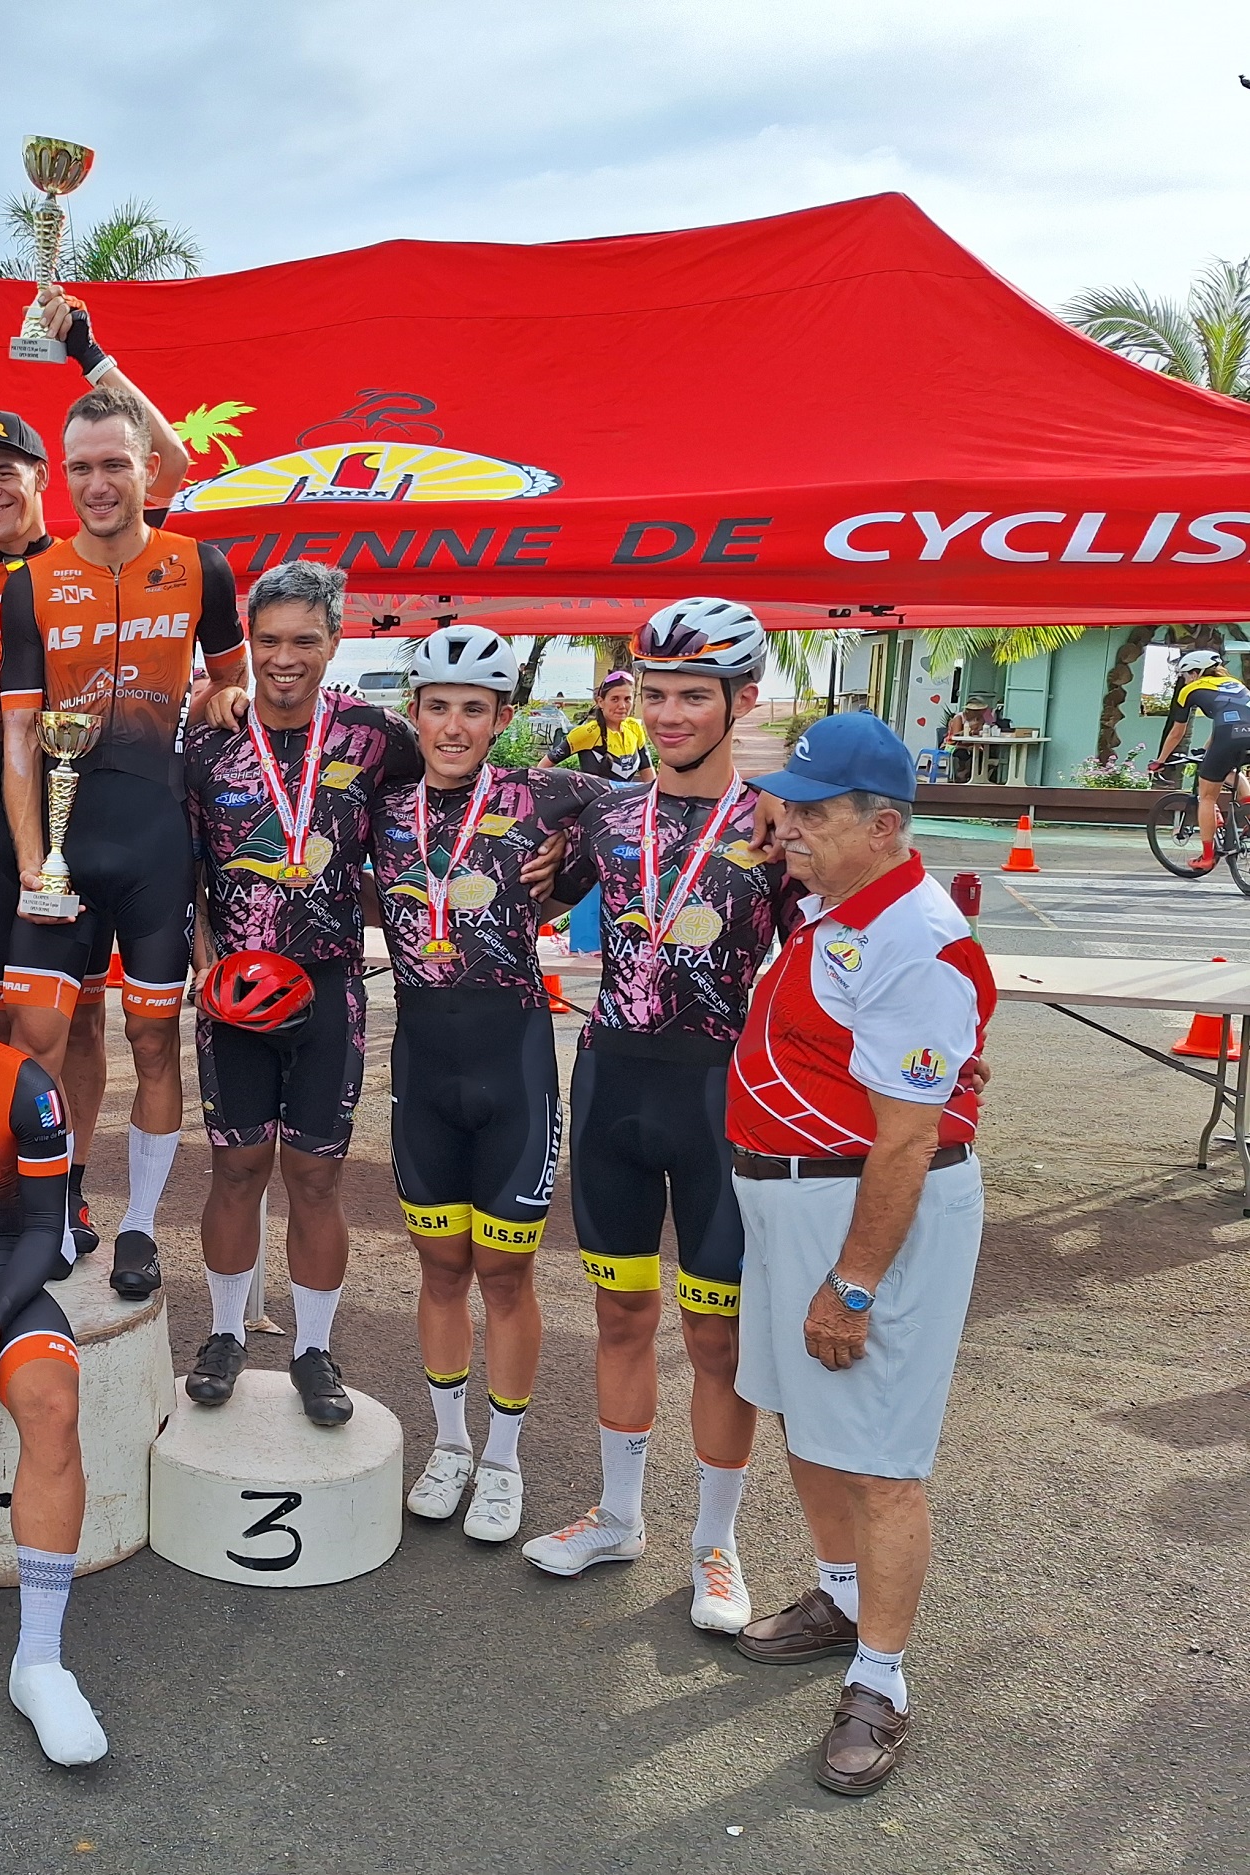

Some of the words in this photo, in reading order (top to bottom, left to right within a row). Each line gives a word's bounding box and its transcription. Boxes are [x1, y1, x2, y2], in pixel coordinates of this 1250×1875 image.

[200, 524, 561, 572] TIENNE
[611, 517, 773, 564] DE
[824, 511, 1250, 563] CYCLIS
[54, 569, 82, 577] DIFFU
[47, 624, 81, 651] AS
[94, 612, 191, 645] PIRAE
[59, 690, 96, 710] NIUHITI
[97, 689, 170, 705] PROMOTION
[174, 691, 192, 754] PIRAE
[305, 898, 342, 932] OROHENA
[474, 929, 519, 966] OROHENA
[83, 985, 106, 995] PIRA
[126, 994, 143, 1004] AS
[146, 996, 177, 1007] PIRAE
[689, 970, 731, 1014] OROHENA
[599, 989, 622, 1030] OROHE
[483, 1223, 537, 1244] U.S.S.H
[582, 1259, 616, 1281] S.S.H
[679, 1282, 737, 1308] U.S.S.H
[48, 1341, 66, 1352] AS
[226, 1490, 302, 1572] 3
